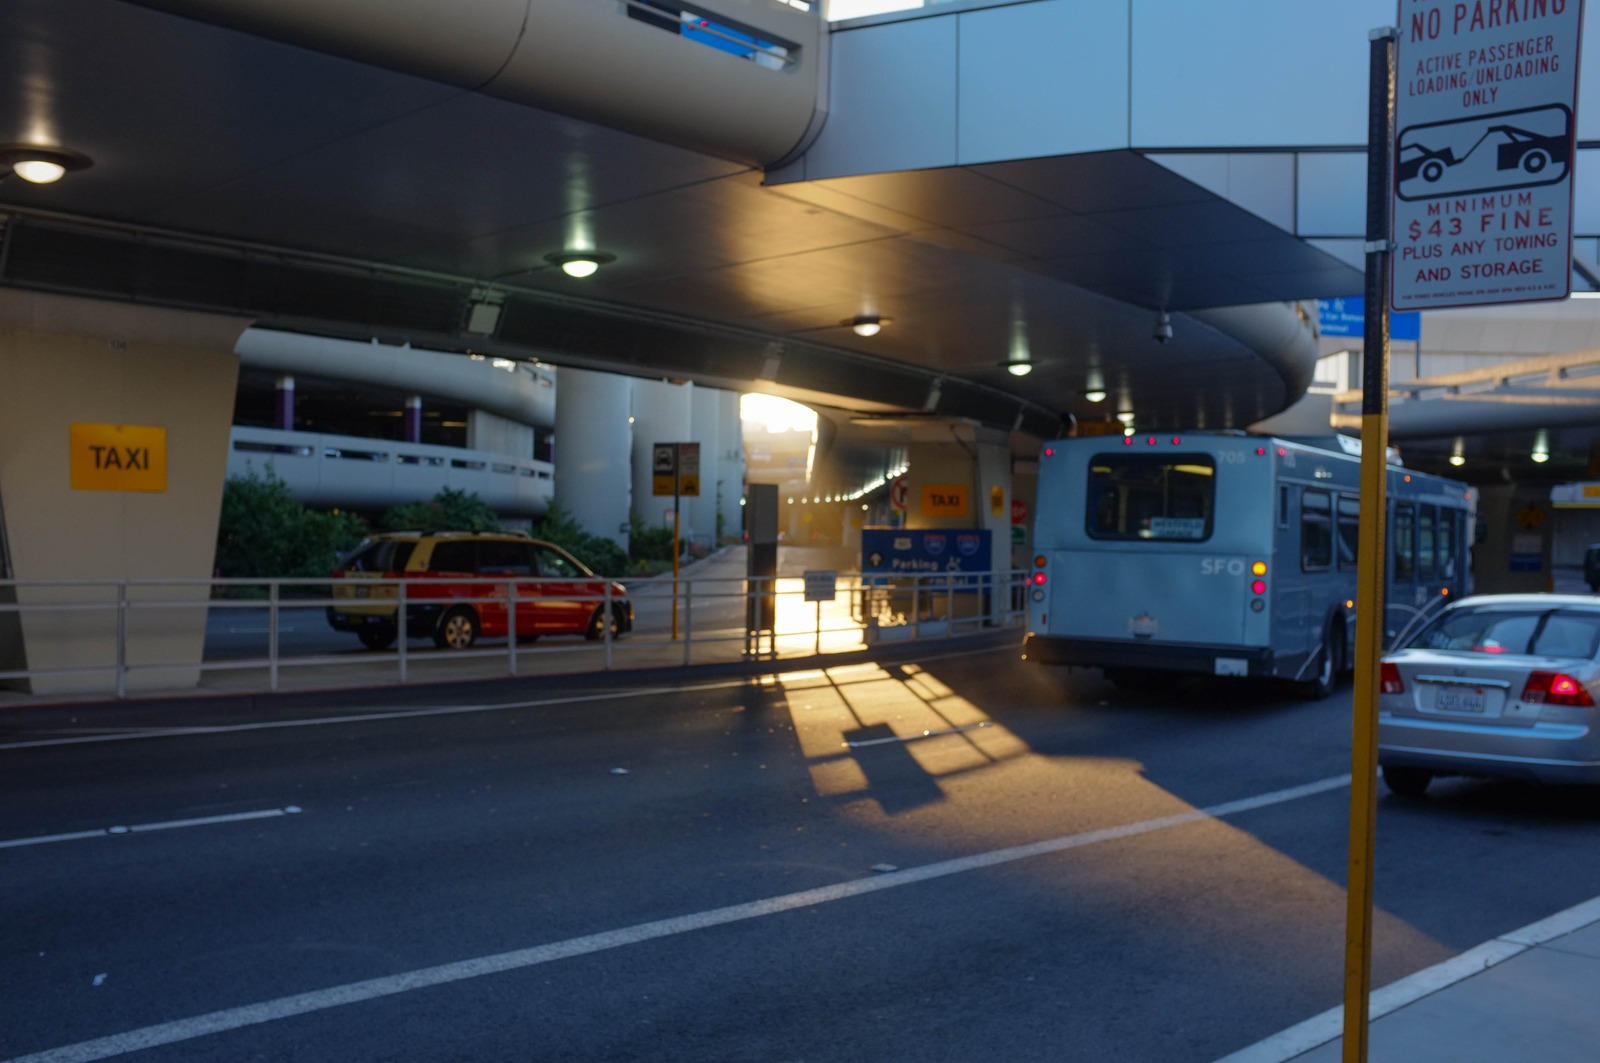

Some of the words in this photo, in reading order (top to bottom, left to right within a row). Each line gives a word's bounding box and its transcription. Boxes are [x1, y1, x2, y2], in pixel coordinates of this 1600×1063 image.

[1411, 8, 1441, 43] NO
[1453, 0, 1566, 35] PARKING
[1416, 52, 1462, 76] ACTIVE
[1468, 35, 1554, 66] PASSENGER
[1409, 55, 1560, 97] LOADING/UNLOADING
[1463, 87, 1498, 108] ONLY
[1427, 191, 1533, 217] MINIMUM
[1408, 218, 1463, 242] $43
[1480, 207, 1554, 233] FINE
[1403, 243, 1443, 260] PLUS
[1450, 239, 1486, 257] ANY
[1495, 232, 1558, 252] TOWING
[1415, 267, 1451, 284] AND
[1460, 258, 1543, 280] STORAGE
[89, 446, 149, 470] TAXI
[930, 494, 961, 507] TAXI
[892, 558, 938, 571] Parking
[1201, 560, 1246, 576] SFO
